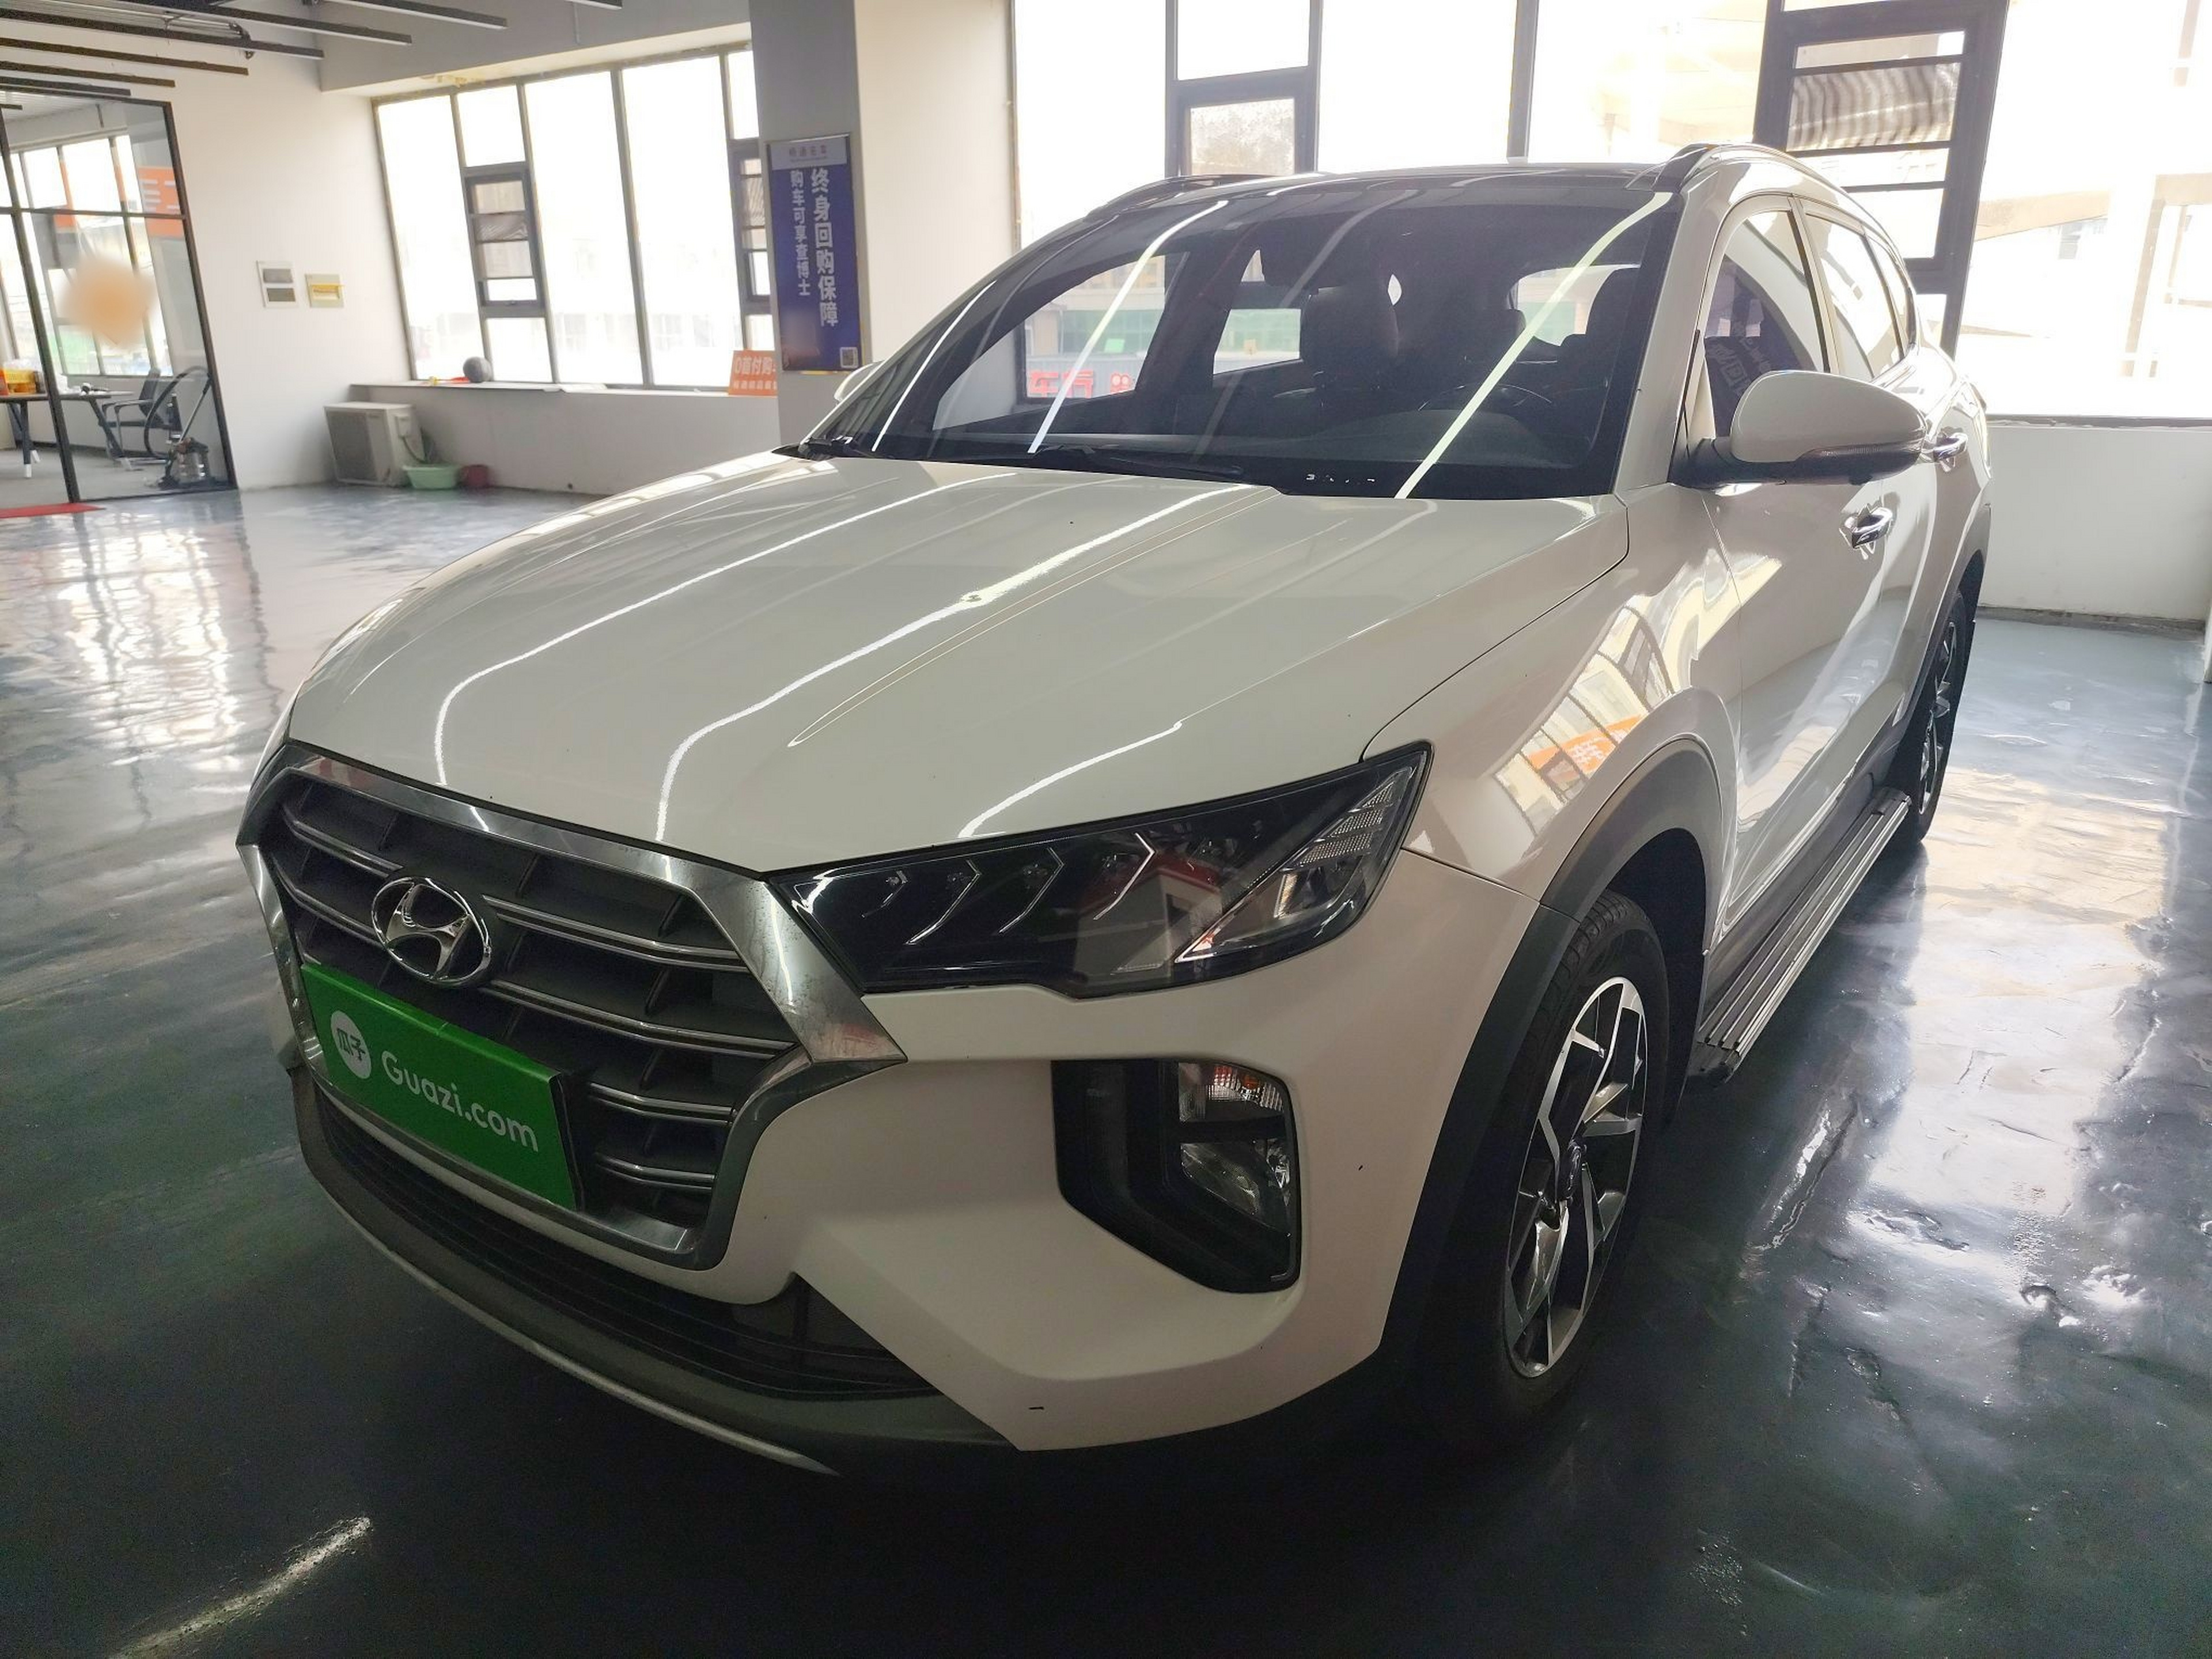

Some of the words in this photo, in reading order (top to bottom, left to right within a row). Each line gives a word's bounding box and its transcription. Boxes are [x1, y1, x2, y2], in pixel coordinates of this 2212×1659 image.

[812, 167, 838, 327] 终身回购保障
[734, 356, 776, 374] 0首付购
[337, 1028, 366, 1061] 瓜子
[381, 1051, 539, 1152] Guazi.com
